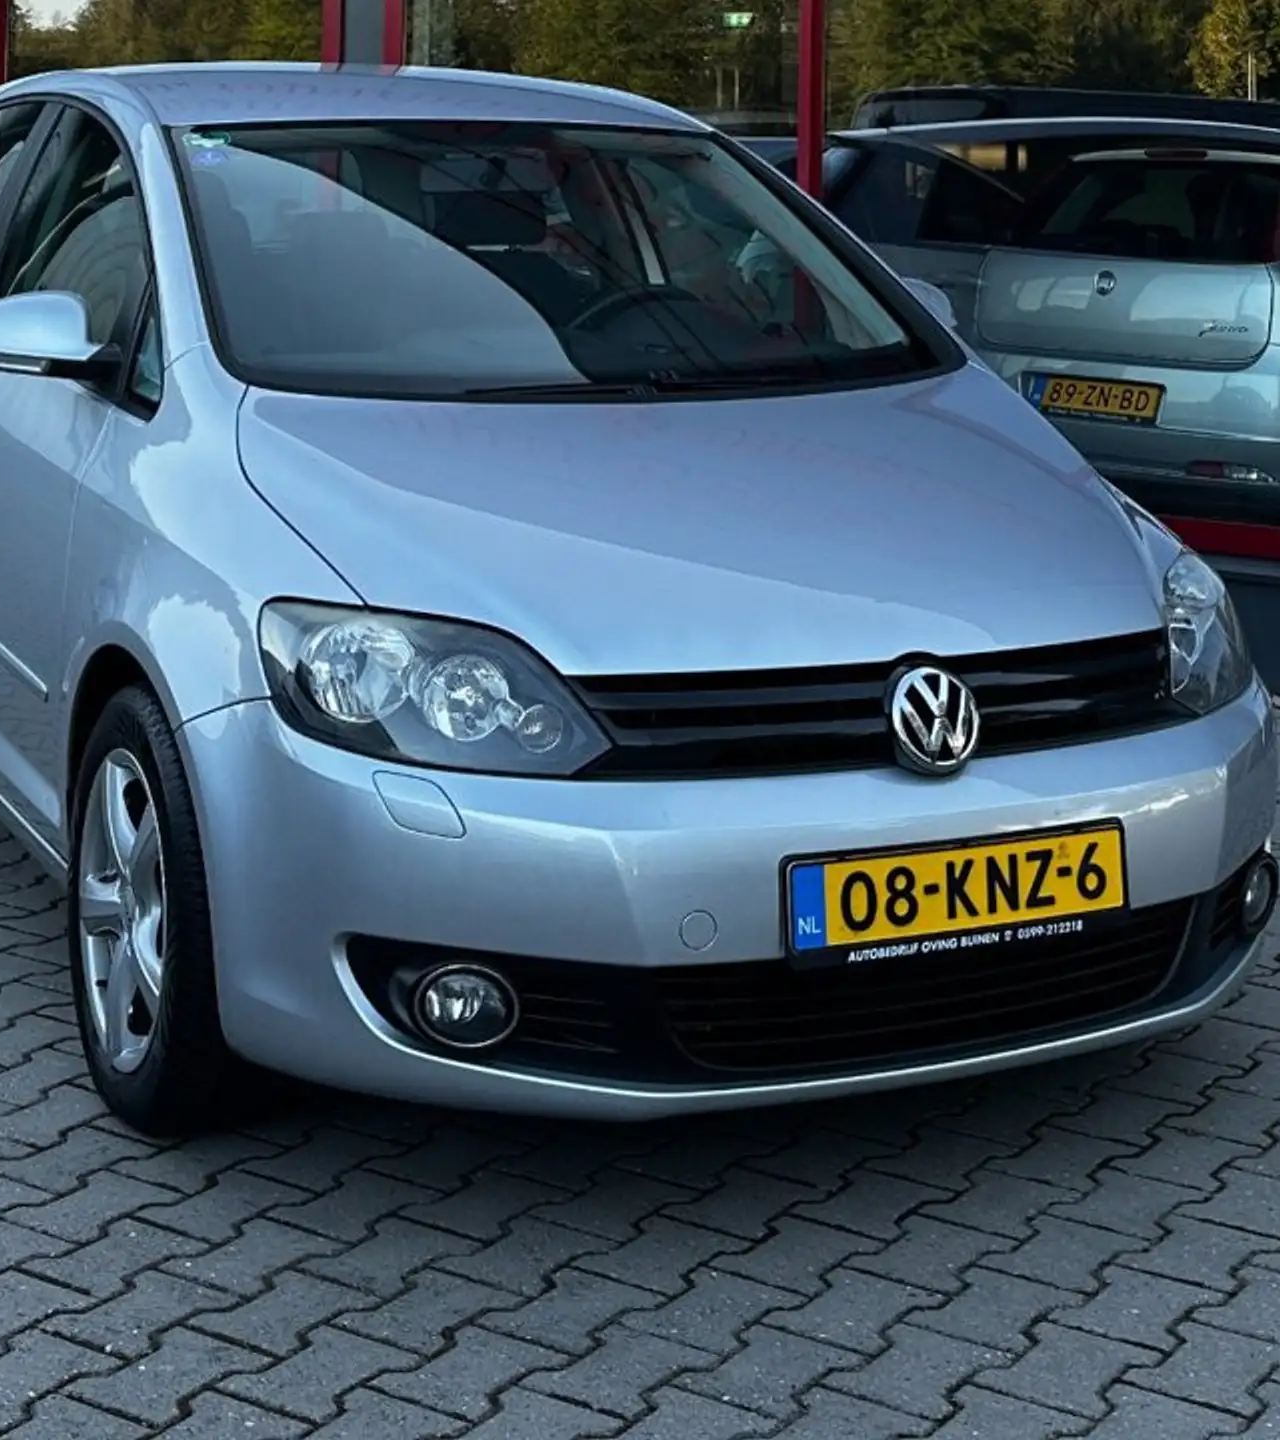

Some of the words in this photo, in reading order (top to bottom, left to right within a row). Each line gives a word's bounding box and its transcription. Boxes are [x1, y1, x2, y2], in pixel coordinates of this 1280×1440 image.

[1050, 381, 1150, 412] 89-ZN-BD
[839, 841, 1108, 933] 08-KNZ-6
[797, 917, 822, 936] NL
[847, 940, 919, 964] AUTOBEDRIJF
[920, 937, 959, 954] OVING
[960, 931, 1001, 948] BUINEN
